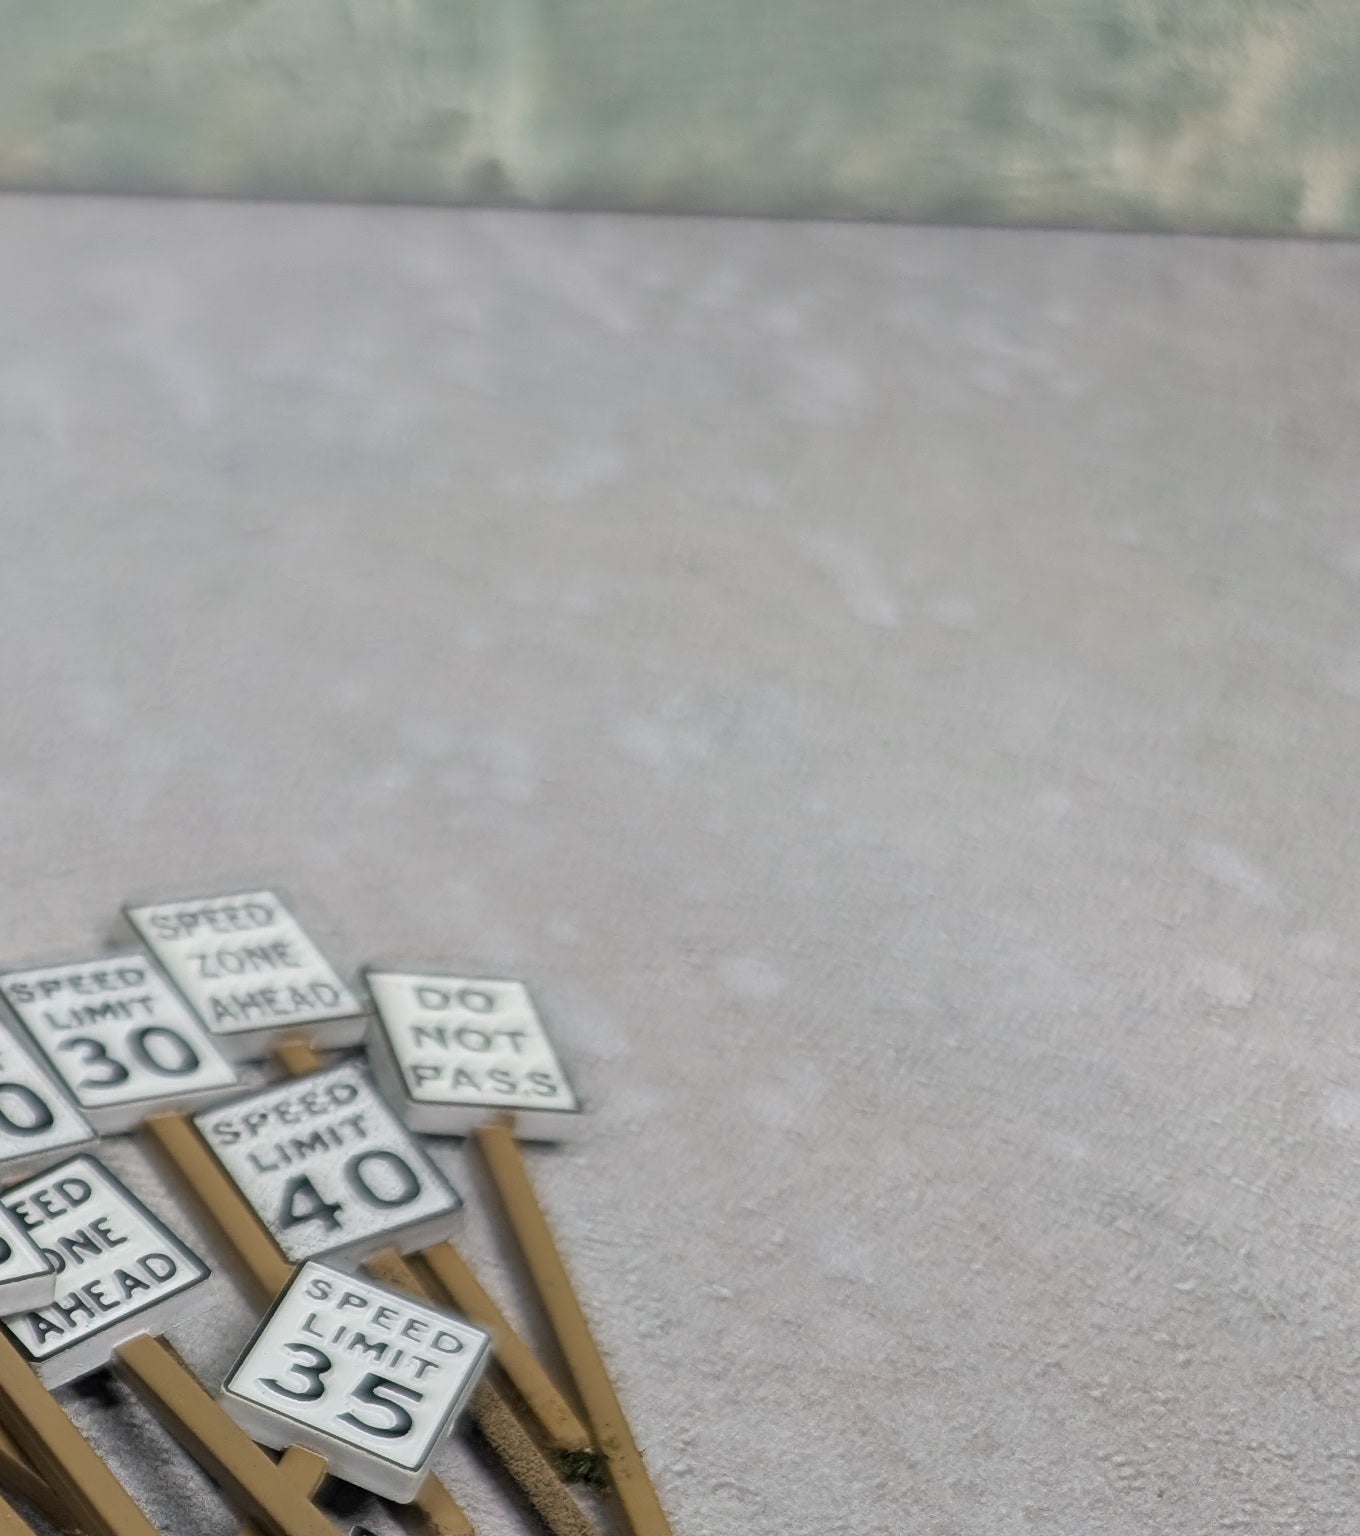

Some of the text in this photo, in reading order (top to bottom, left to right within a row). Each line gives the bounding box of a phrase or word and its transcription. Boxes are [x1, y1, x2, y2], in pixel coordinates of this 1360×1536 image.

[151, 903, 274, 942] SPEED
[10, 968, 145, 1002] SPEED
[193, 943, 305, 979] ZONE
[44, 996, 153, 1031] LIMIT
[212, 983, 339, 1023] AHEAD
[414, 986, 493, 1013] DO
[59, 1027, 199, 1087] 30
[413, 1024, 528, 1056] NOT
[413, 1064, 558, 1098] PASS
[212, 1083, 358, 1145] SPEED
[247, 1114, 370, 1173] LIMIT
[6, 1178, 92, 1232] EED
[282, 1150, 420, 1233] 40
[27, 1252, 177, 1344] AHEAD
[305, 1278, 464, 1356] SPEED
[302, 1312, 441, 1381] LIMIT
[258, 1341, 424, 1439] 35
